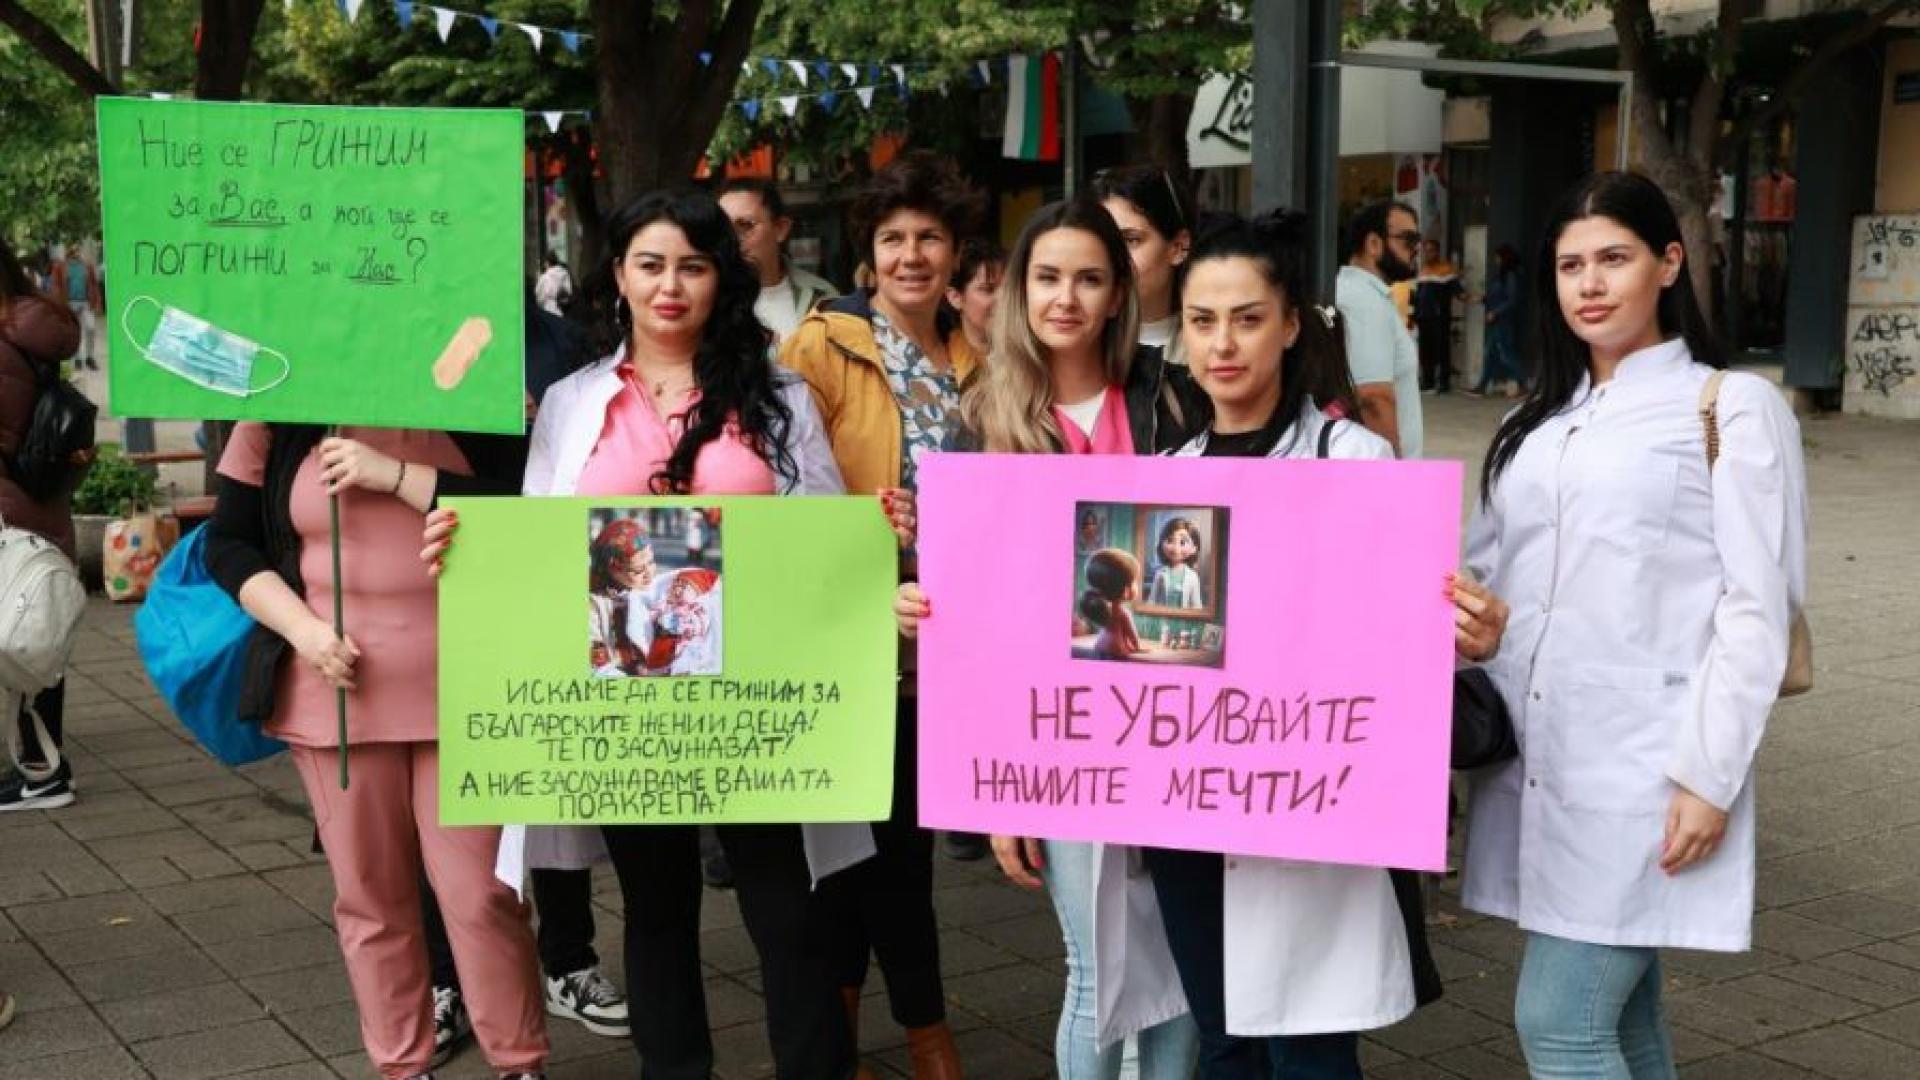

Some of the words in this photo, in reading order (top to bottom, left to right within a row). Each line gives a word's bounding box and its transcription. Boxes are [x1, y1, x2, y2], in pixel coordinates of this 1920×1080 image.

[138, 119, 203, 169] Ние
[220, 143, 249, 168] се
[271, 119, 428, 170] ГРИЖИМ
[168, 193, 201, 219] за
[300, 203, 312, 222] а
[388, 208, 417, 241] ще
[430, 210, 451, 226] се
[134, 241, 287, 276] ПОГРИЖИ
[507, 678, 619, 705] ИСКАМЕ
[625, 680, 657, 704] ДА
[672, 680, 701, 703] СЕ
[710, 678, 806, 704] ГРИЖИМ
[812, 680, 841, 704] ЗА
[467, 712, 633, 740] БЪЛГАРСКИТЕ
[640, 710, 706, 736] ЖЕНИ
[709, 712, 728, 735] И
[733, 707, 820, 736] ДЕЦА!
[1030, 686, 1093, 741] НЕ
[1109, 684, 1377, 748] УБИВАЙТЕ
[537, 737, 574, 762] ТЕ
[582, 736, 609, 762] ГО
[460, 770, 480, 799] А
[488, 770, 536, 797] НИЕ
[537, 768, 706, 795] ЗАСЛУЖАВАМЕ
[715, 765, 837, 795] ВАШАТА
[972, 757, 1130, 806] НАШИТЕ
[1161, 765, 1353, 814] МЕЧТИ!
[558, 789, 728, 819] ПОДКРЕПА!
